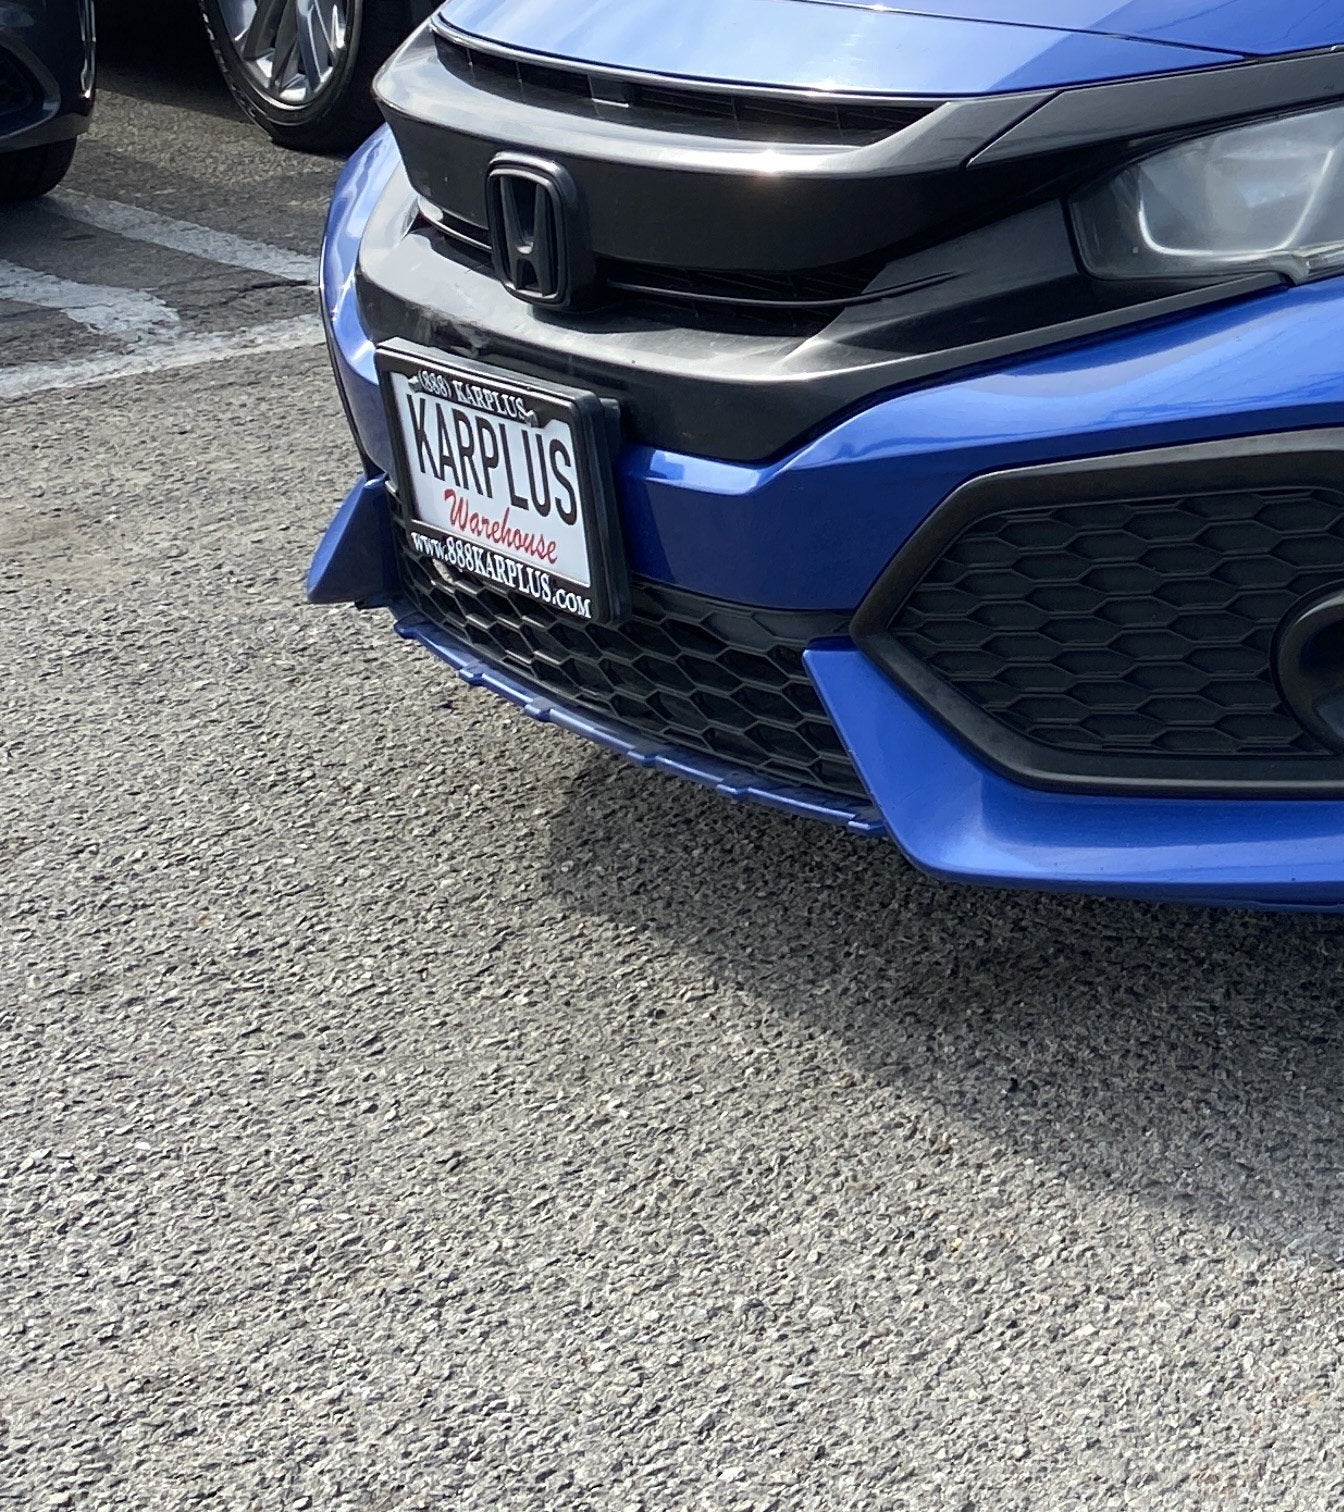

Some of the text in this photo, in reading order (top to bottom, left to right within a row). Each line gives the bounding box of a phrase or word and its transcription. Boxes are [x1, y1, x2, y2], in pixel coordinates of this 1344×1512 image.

[417, 370, 527, 420] (888) KARPLUS
[406, 392, 578, 526] KARPLUS
[443, 488, 558, 565] Warehouse
